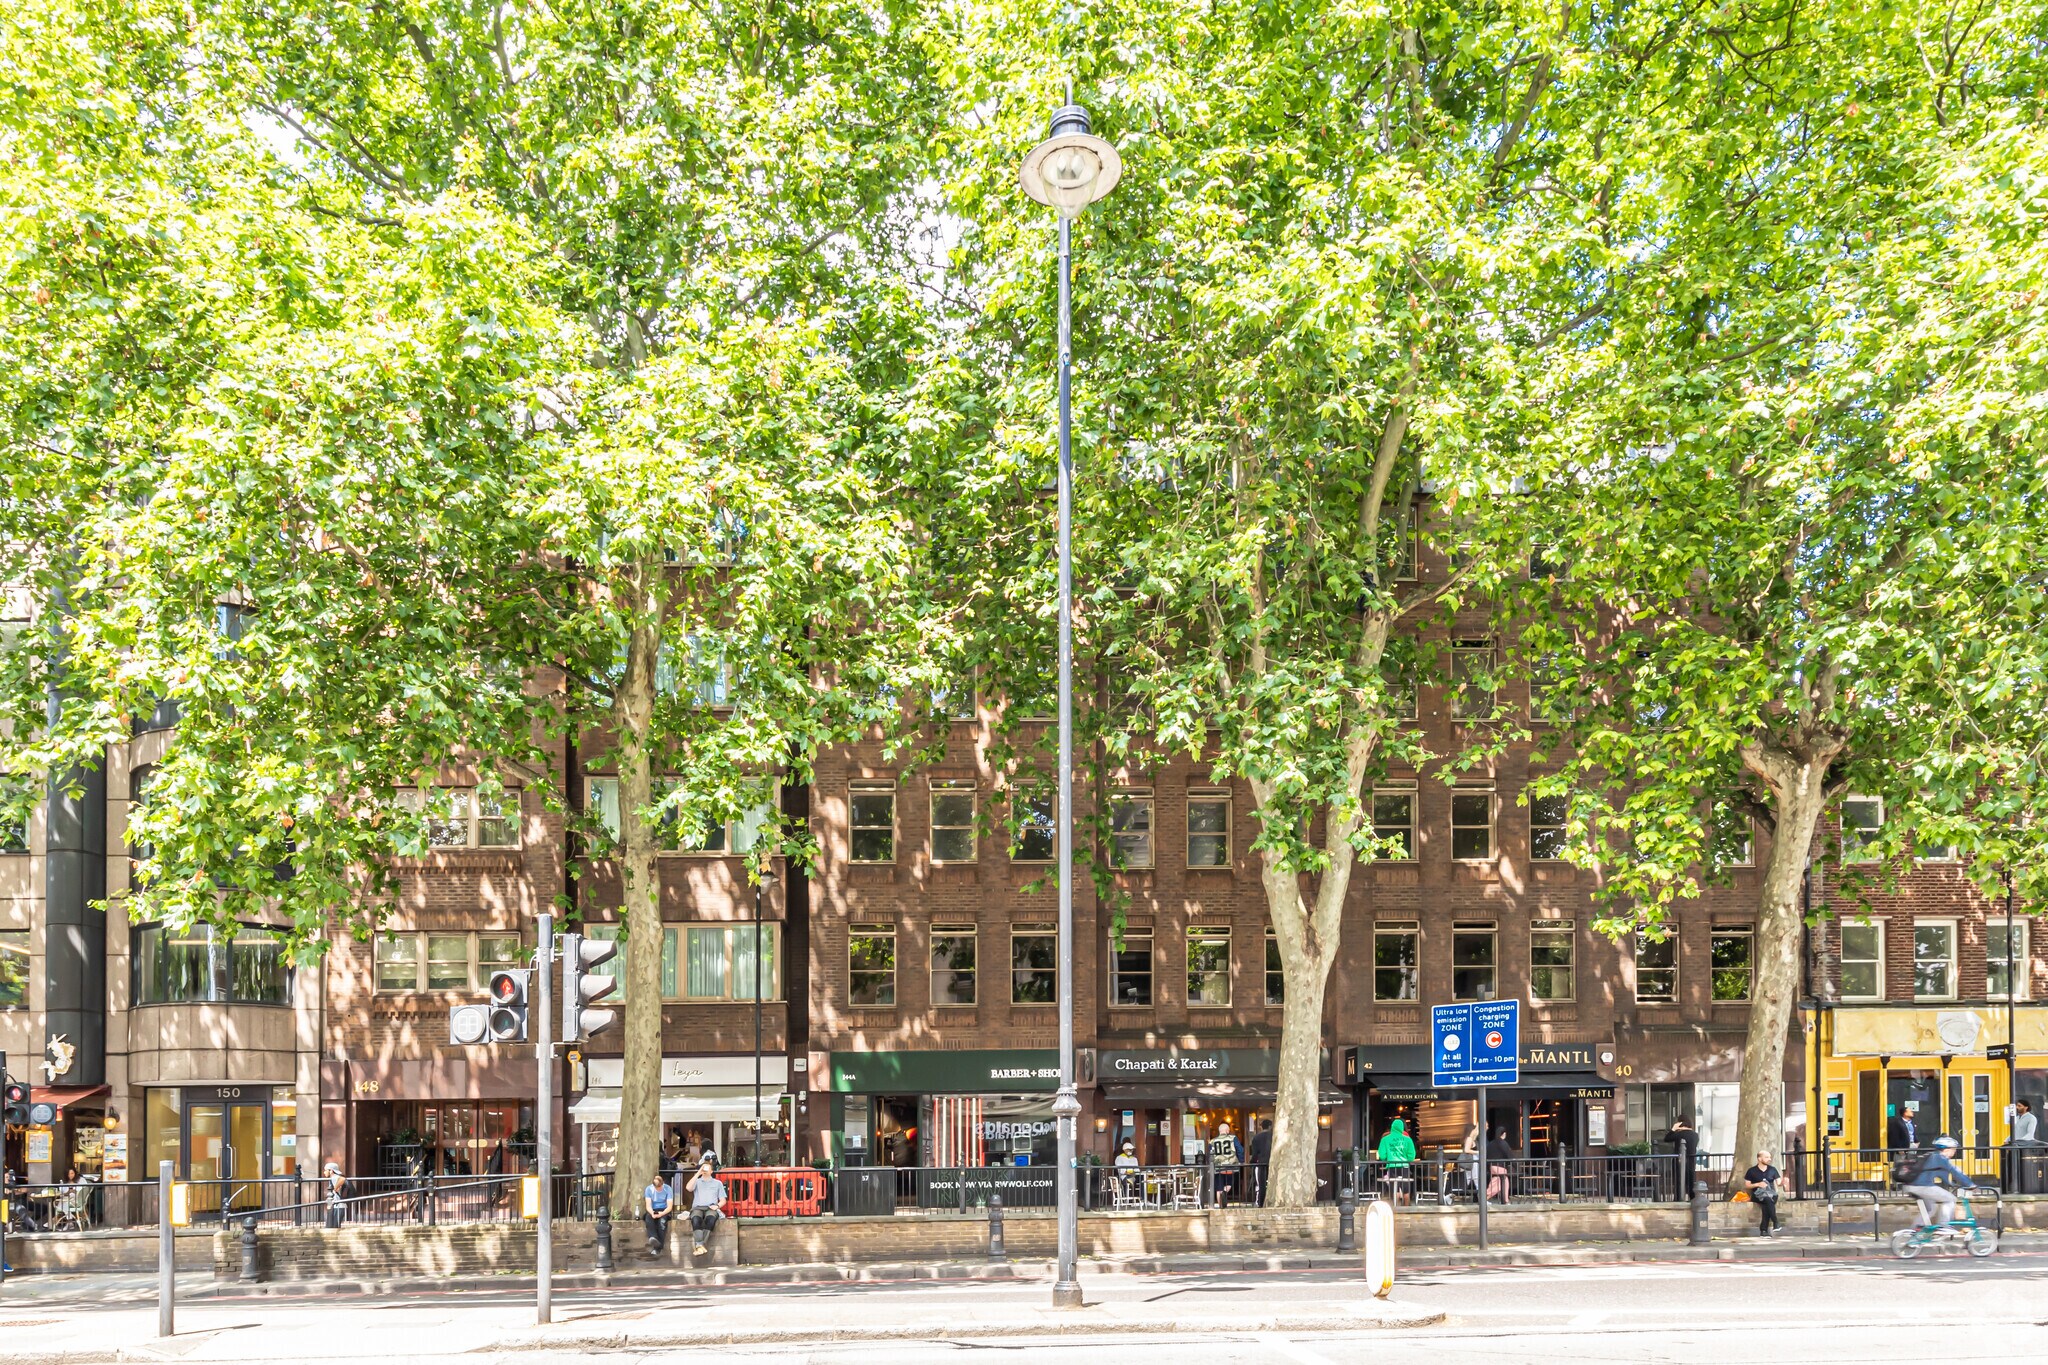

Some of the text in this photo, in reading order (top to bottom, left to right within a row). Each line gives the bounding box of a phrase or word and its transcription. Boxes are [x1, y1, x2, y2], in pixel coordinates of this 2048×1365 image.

[1474, 1004, 1515, 1013] Congestion
[1479, 1013, 1510, 1021] charging
[1442, 1053, 1450, 1061] At
[1494, 1055, 1503, 1063] 10
[1530, 1049, 1592, 1064] MANTL
[1115, 1058, 1217, 1073] Chapati & Karak
[1363, 1062, 1374, 1070] 42
[1615, 1064, 1632, 1077] 40
[1475, 1074, 1498, 1082] ahead
[354, 1080, 379, 1093] 148
[215, 1087, 241, 1099] 150
[1577, 1088, 1612, 1098] MANTL
[1214, 1139, 1231, 1155] 02
[930, 1181, 954, 1190] BOOK
[977, 1181, 993, 1189] VIA
